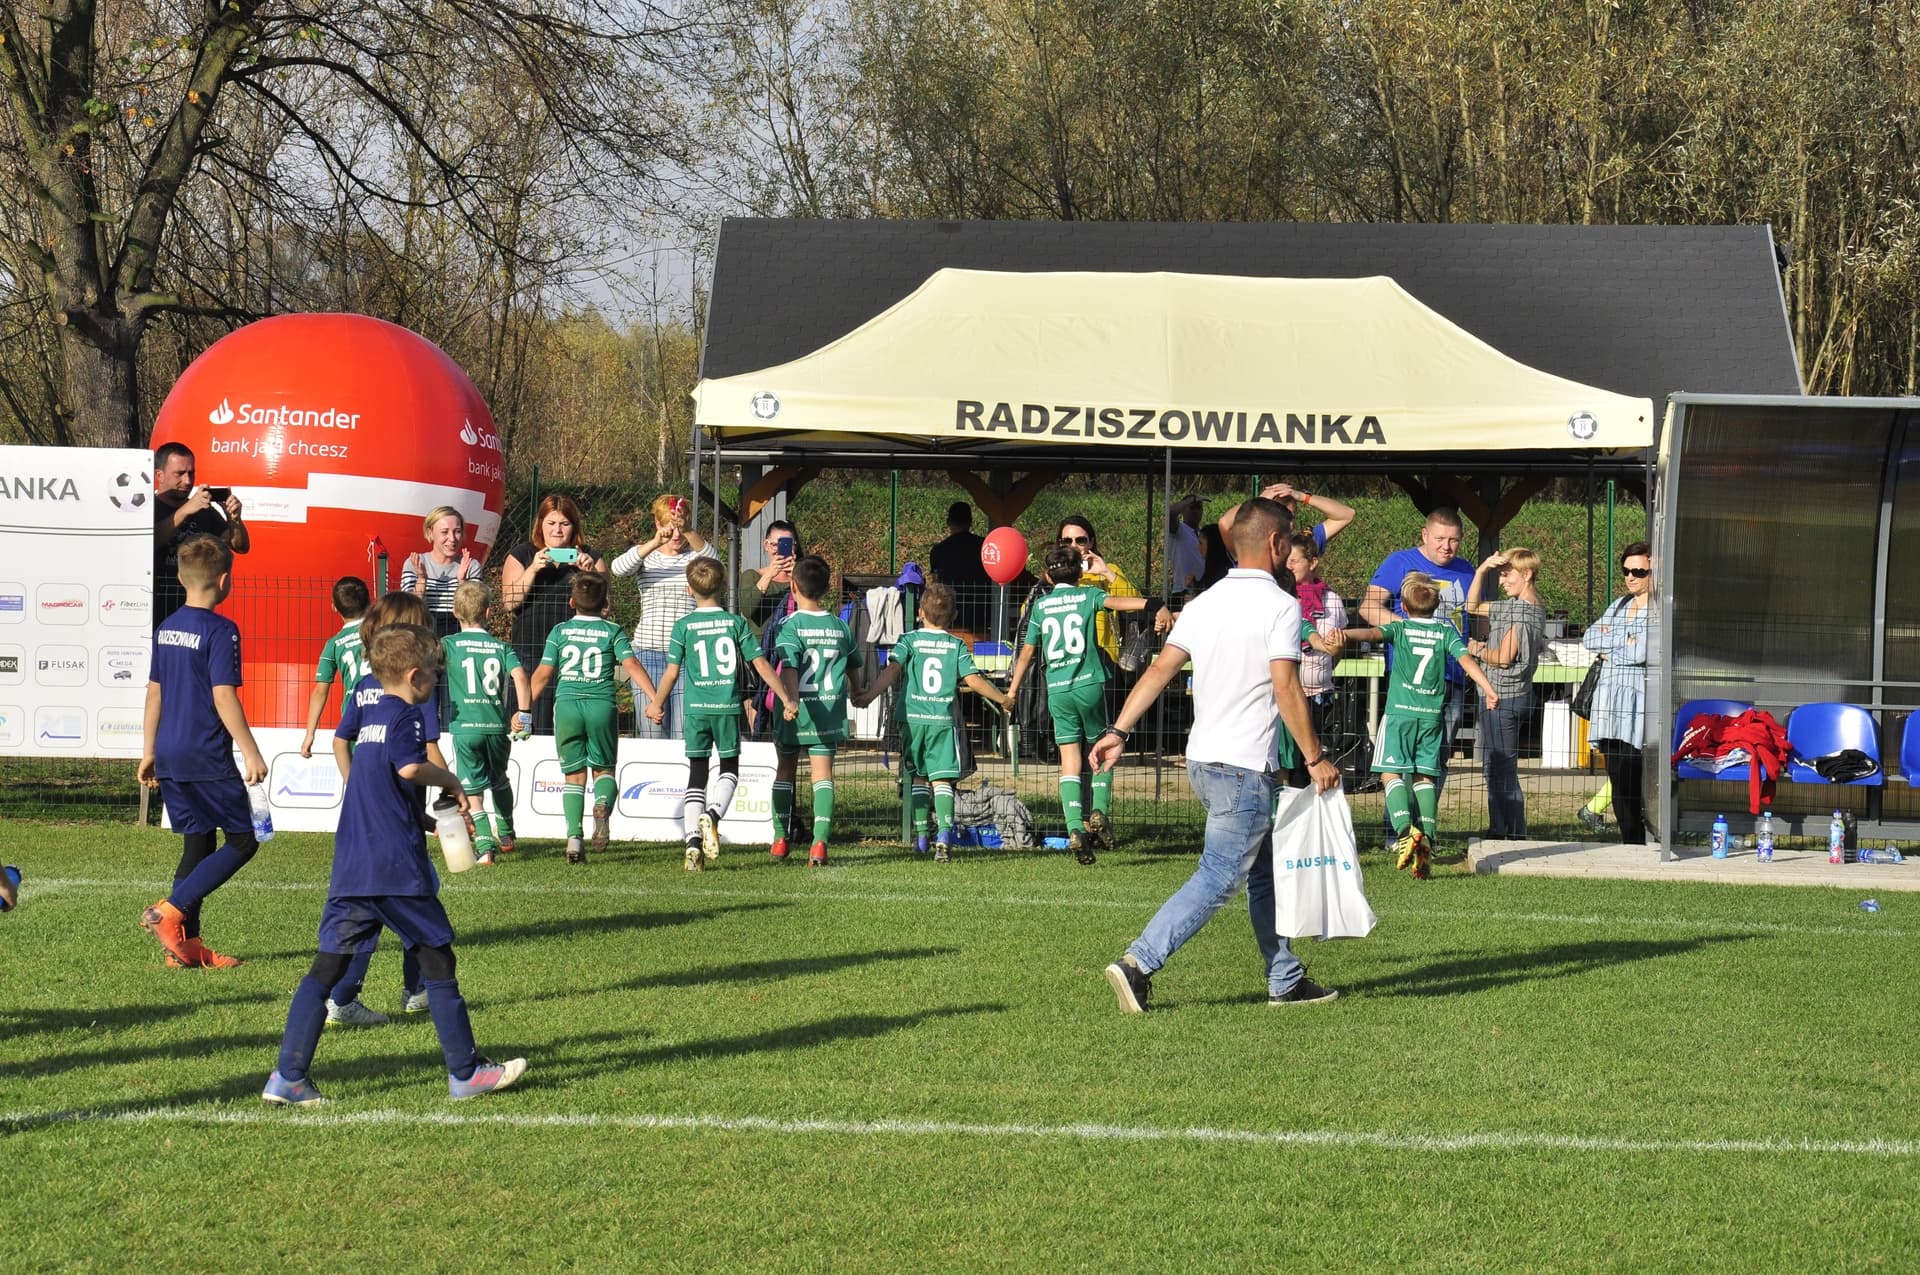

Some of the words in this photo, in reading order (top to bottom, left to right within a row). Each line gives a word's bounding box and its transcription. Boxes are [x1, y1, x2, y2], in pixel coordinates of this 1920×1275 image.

[237, 404, 361, 430] Santander
[955, 400, 1387, 445] RADZISZOWIANKA
[211, 437, 249, 453] bank
[288, 440, 348, 458] chcesz
[468, 457, 490, 478] bank
[0, 477, 80, 501] ANKA
[1042, 613, 1085, 660] 26
[51, 661, 85, 669] FLISAK
[560, 645, 603, 678] 20
[693, 636, 737, 678] 19
[798, 648, 840, 692] 27
[1412, 646, 1434, 685] 7
[461, 656, 501, 696] 18
[922, 656, 943, 694] 6
[735, 800, 771, 813] BUD
